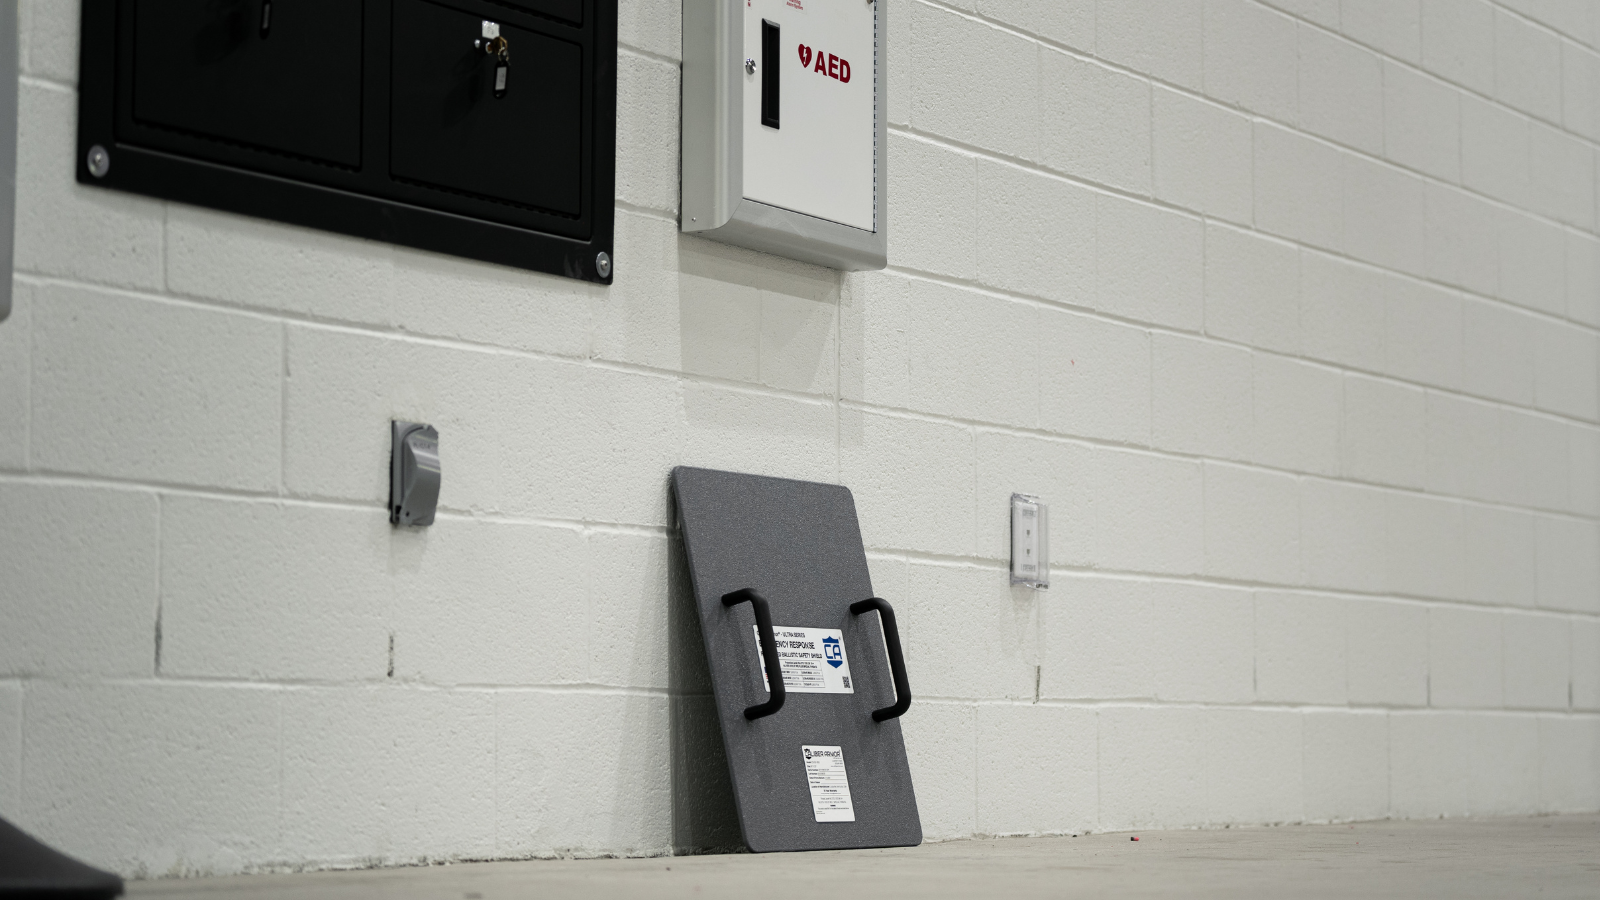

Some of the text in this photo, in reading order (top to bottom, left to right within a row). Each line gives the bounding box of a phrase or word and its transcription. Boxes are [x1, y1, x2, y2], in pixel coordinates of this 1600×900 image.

[814, 51, 851, 83] AED
[790, 641, 815, 649] RESPONSE
[824, 644, 842, 659] CA
